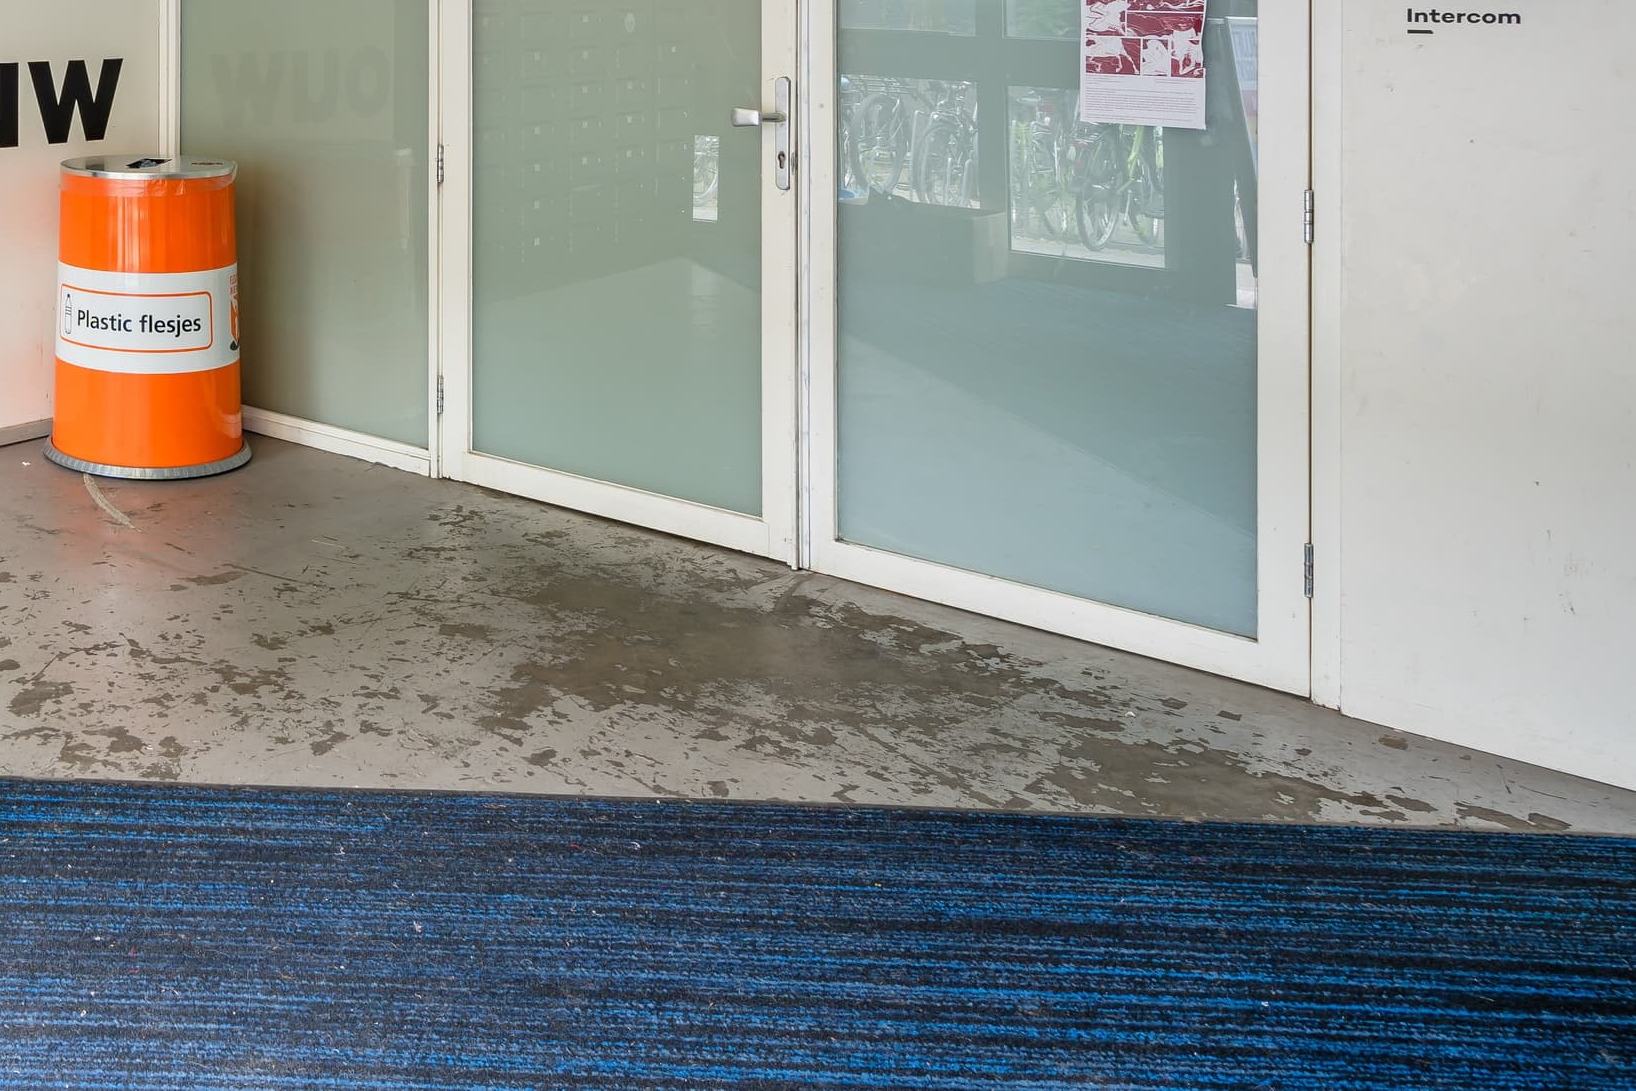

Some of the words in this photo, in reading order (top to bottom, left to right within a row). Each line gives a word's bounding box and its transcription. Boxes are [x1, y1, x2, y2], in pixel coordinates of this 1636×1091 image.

[1407, 8, 1521, 24] Intercom
[77, 309, 133, 333] Plastic
[139, 314, 201, 338] flesjes
